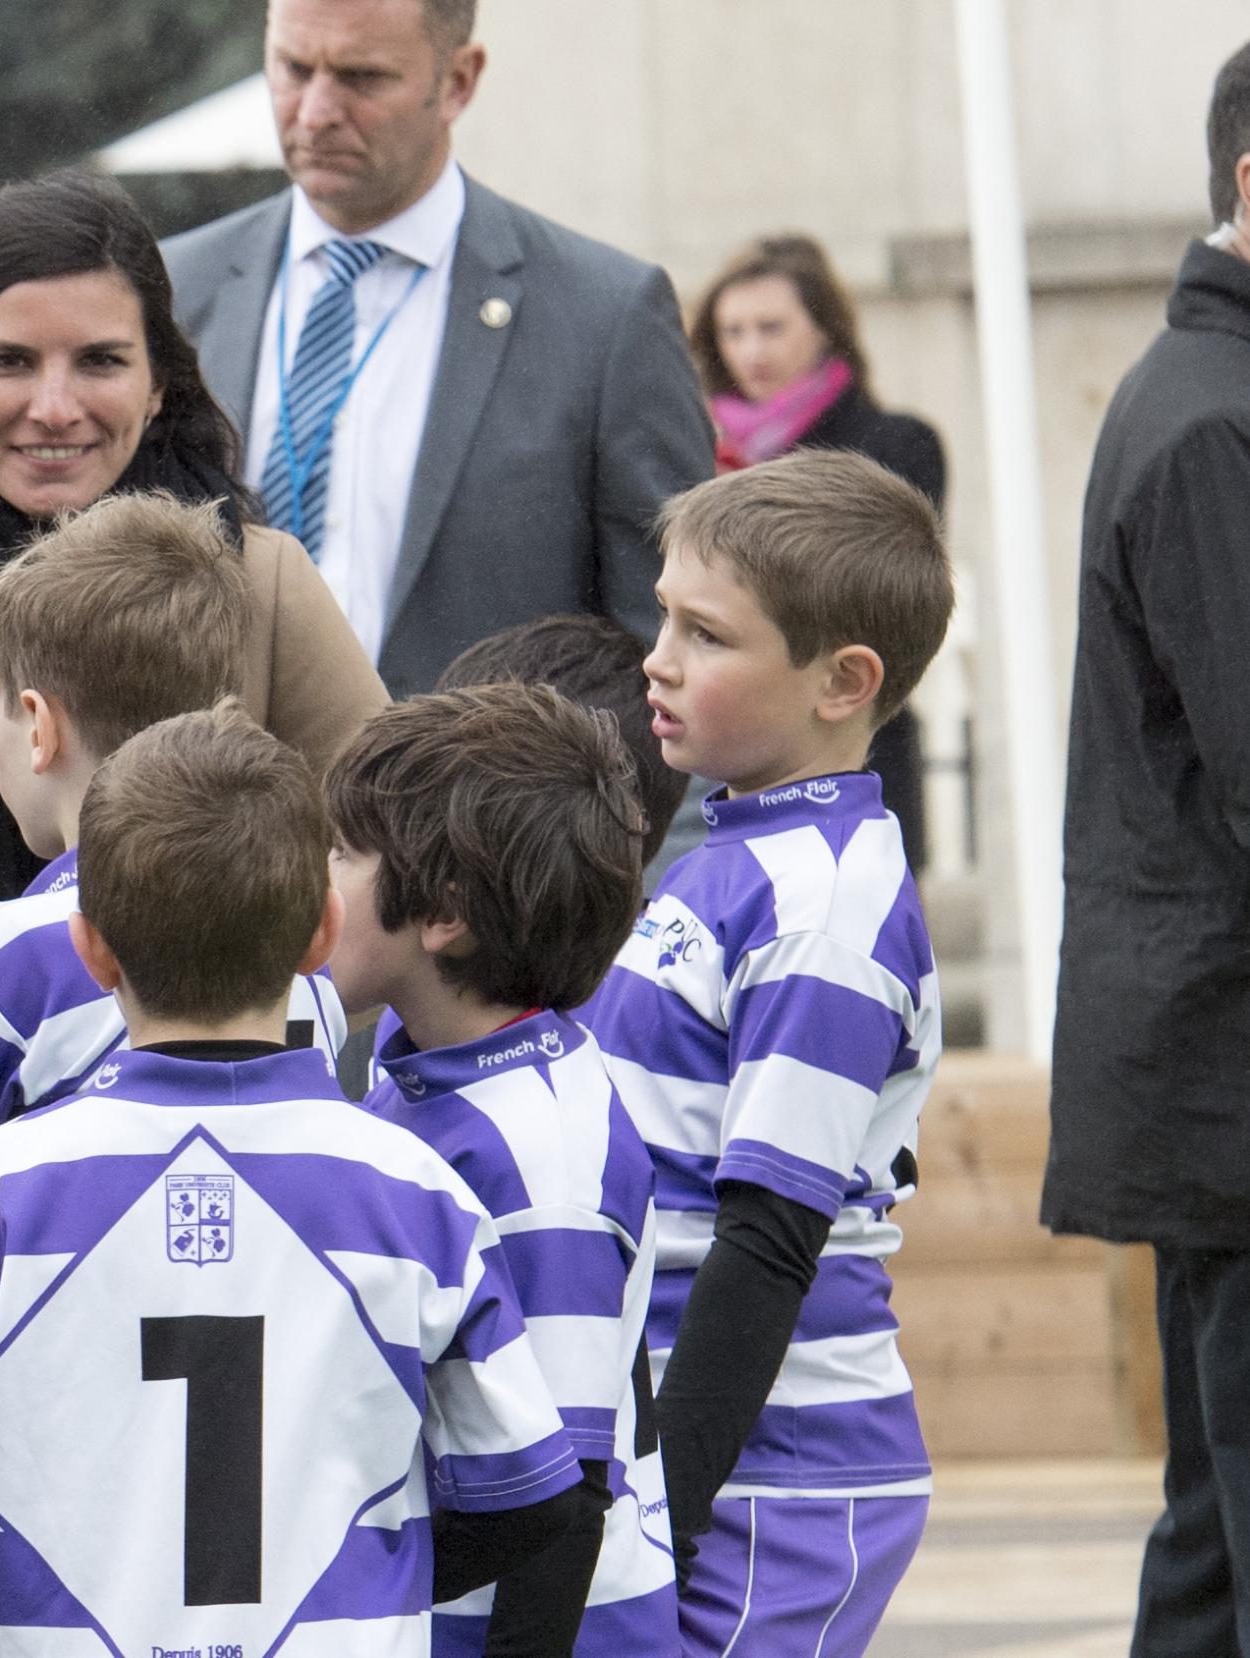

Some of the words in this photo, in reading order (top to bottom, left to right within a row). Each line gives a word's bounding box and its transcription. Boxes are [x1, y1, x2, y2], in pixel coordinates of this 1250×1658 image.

[758, 785, 802, 808] French
[805, 778, 838, 798] Flair
[477, 1041, 534, 1069] French
[140, 1315, 265, 1606] 1
[207, 1644, 244, 1658] 1906
